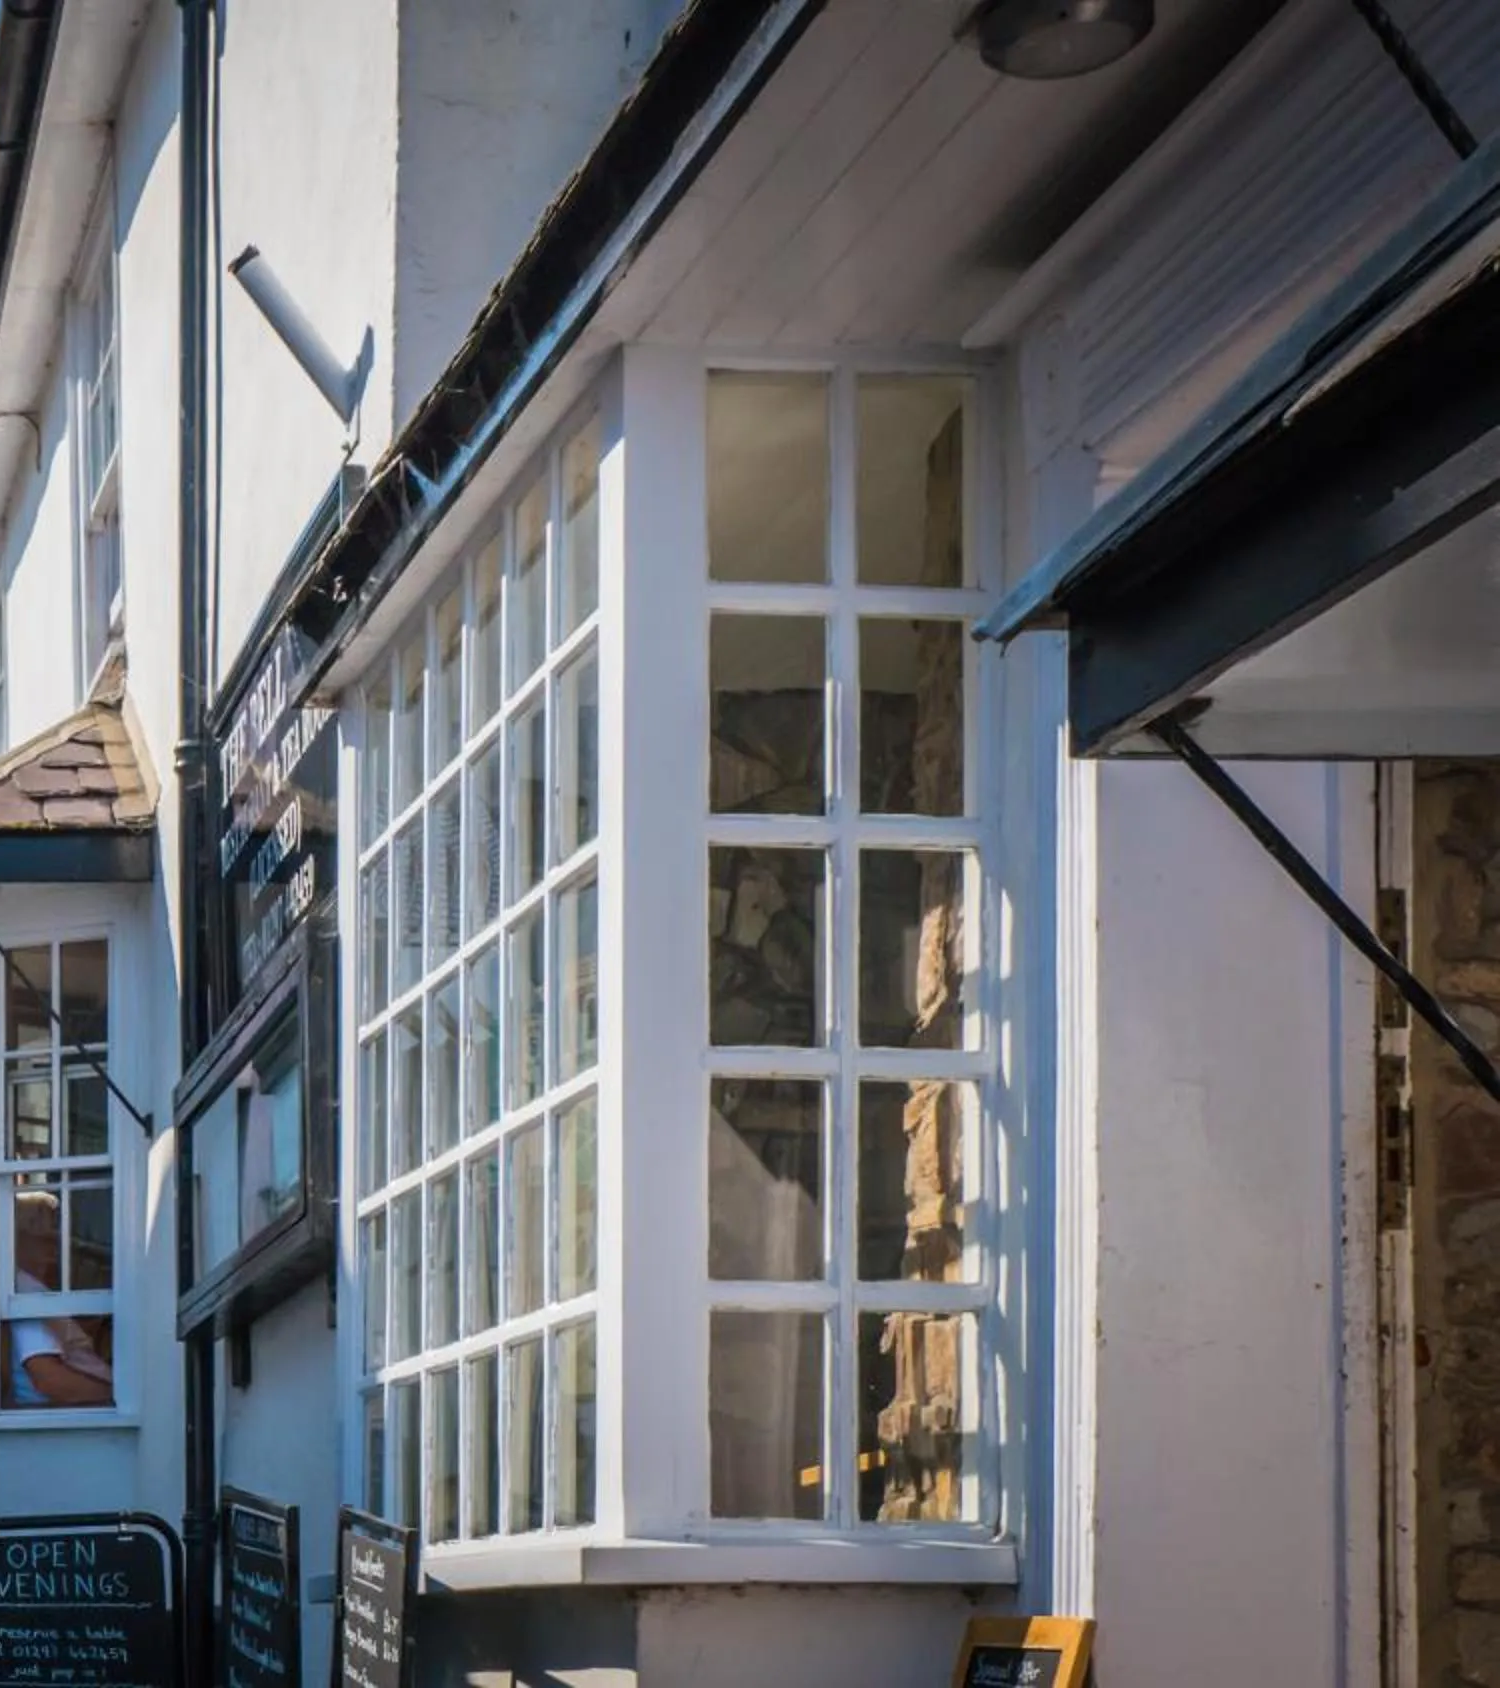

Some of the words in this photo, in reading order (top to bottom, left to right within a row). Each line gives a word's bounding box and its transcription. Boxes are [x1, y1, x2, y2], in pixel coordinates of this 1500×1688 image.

[219, 710, 247, 807] THE
[253, 645, 287, 748] BELL
[6, 1539, 97, 1569] OPEN
